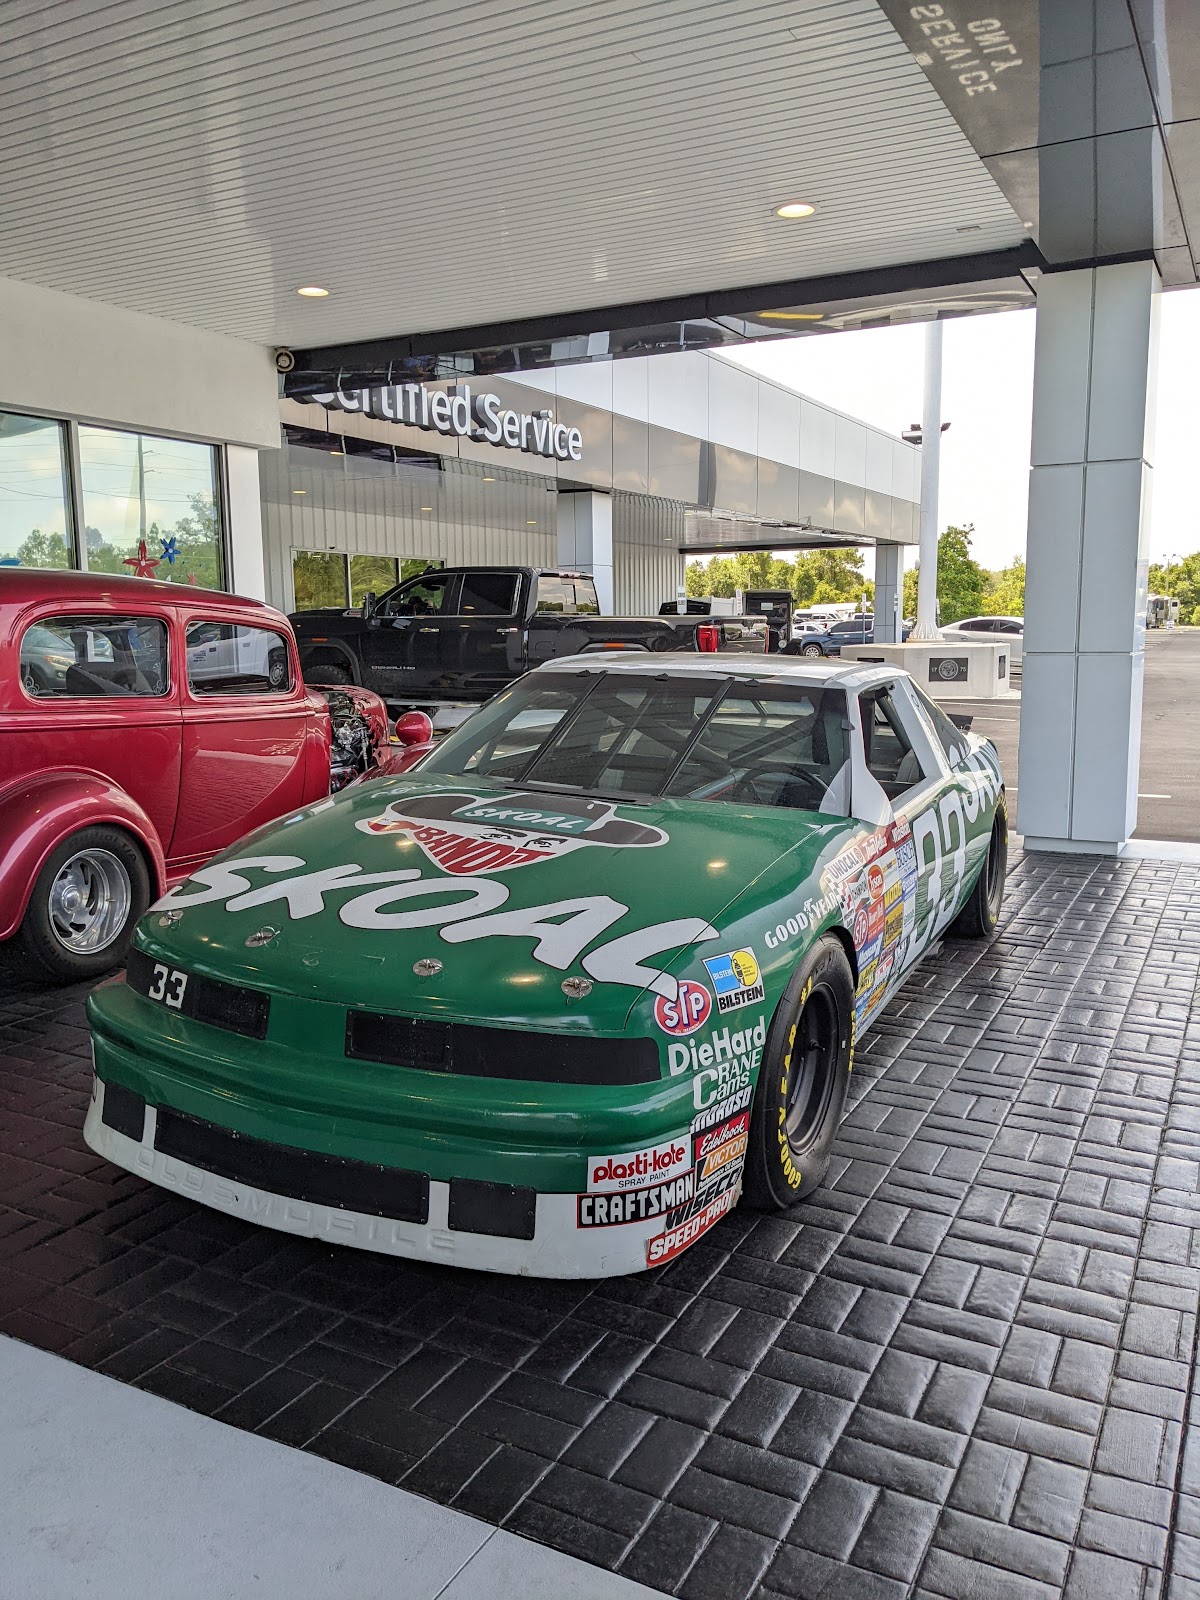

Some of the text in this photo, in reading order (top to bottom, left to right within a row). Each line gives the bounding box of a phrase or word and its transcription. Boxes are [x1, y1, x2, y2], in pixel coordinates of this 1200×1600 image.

[311, 384, 583, 461] ertified Service
[465, 807, 584, 829] SKOAL
[415, 826, 556, 875] BANDIT
[827, 851, 859, 879] UNOCAL
[149, 856, 720, 1002] SKOAL
[855, 912, 867, 946] STP
[148, 963, 188, 1011] 33
[712, 970, 733, 981] BILSTEIN
[719, 984, 764, 1011] BILSTEIN
[663, 984, 704, 1028] STP
[667, 1015, 767, 1077] DieHard
[693, 1047, 762, 1110] CRANE
[690, 1085, 752, 1134] MOROSO
[700, 1116, 745, 1156] Edelbrock
[708, 1139, 745, 1170] VICTOR
[593, 1144, 686, 1184] plasti-kote
[618, 1169, 671, 1189] SPRAY PAINT
[581, 1172, 693, 1227] CRAFTSMAN
[650, 1191, 730, 1261] SPEED-PRO
